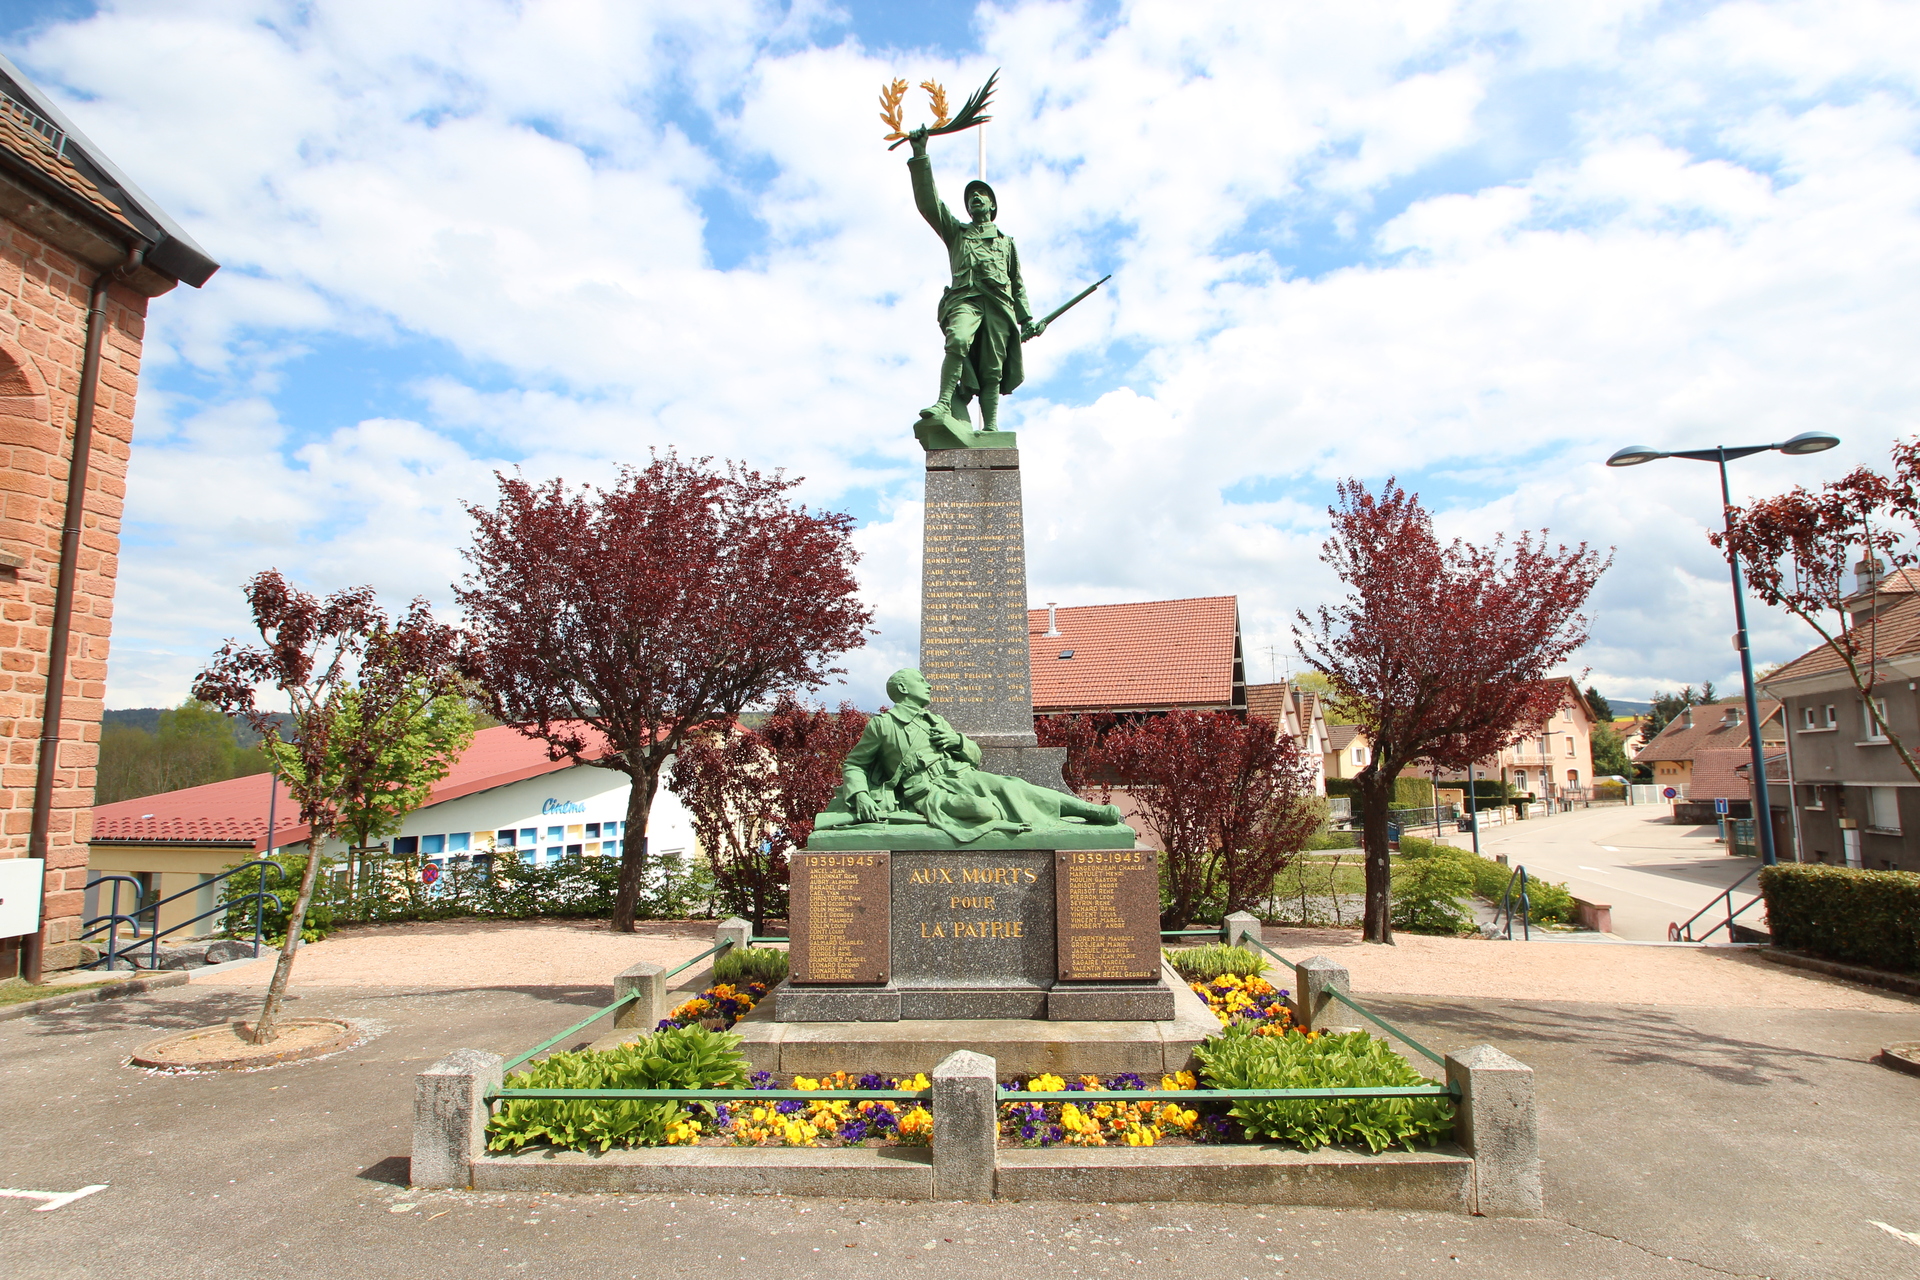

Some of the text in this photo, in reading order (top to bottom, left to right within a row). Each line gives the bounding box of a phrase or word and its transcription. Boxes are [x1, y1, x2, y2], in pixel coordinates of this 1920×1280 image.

[542, 798, 586, 815] Cinéma
[806, 856, 874, 866] 1939-1945
[1072, 853, 1141, 864] 1939-1945
[909, 867, 1038, 885] AUX MORTS
[951, 896, 996, 910] POUR
[920, 921, 1025, 939] LA PATRIE
